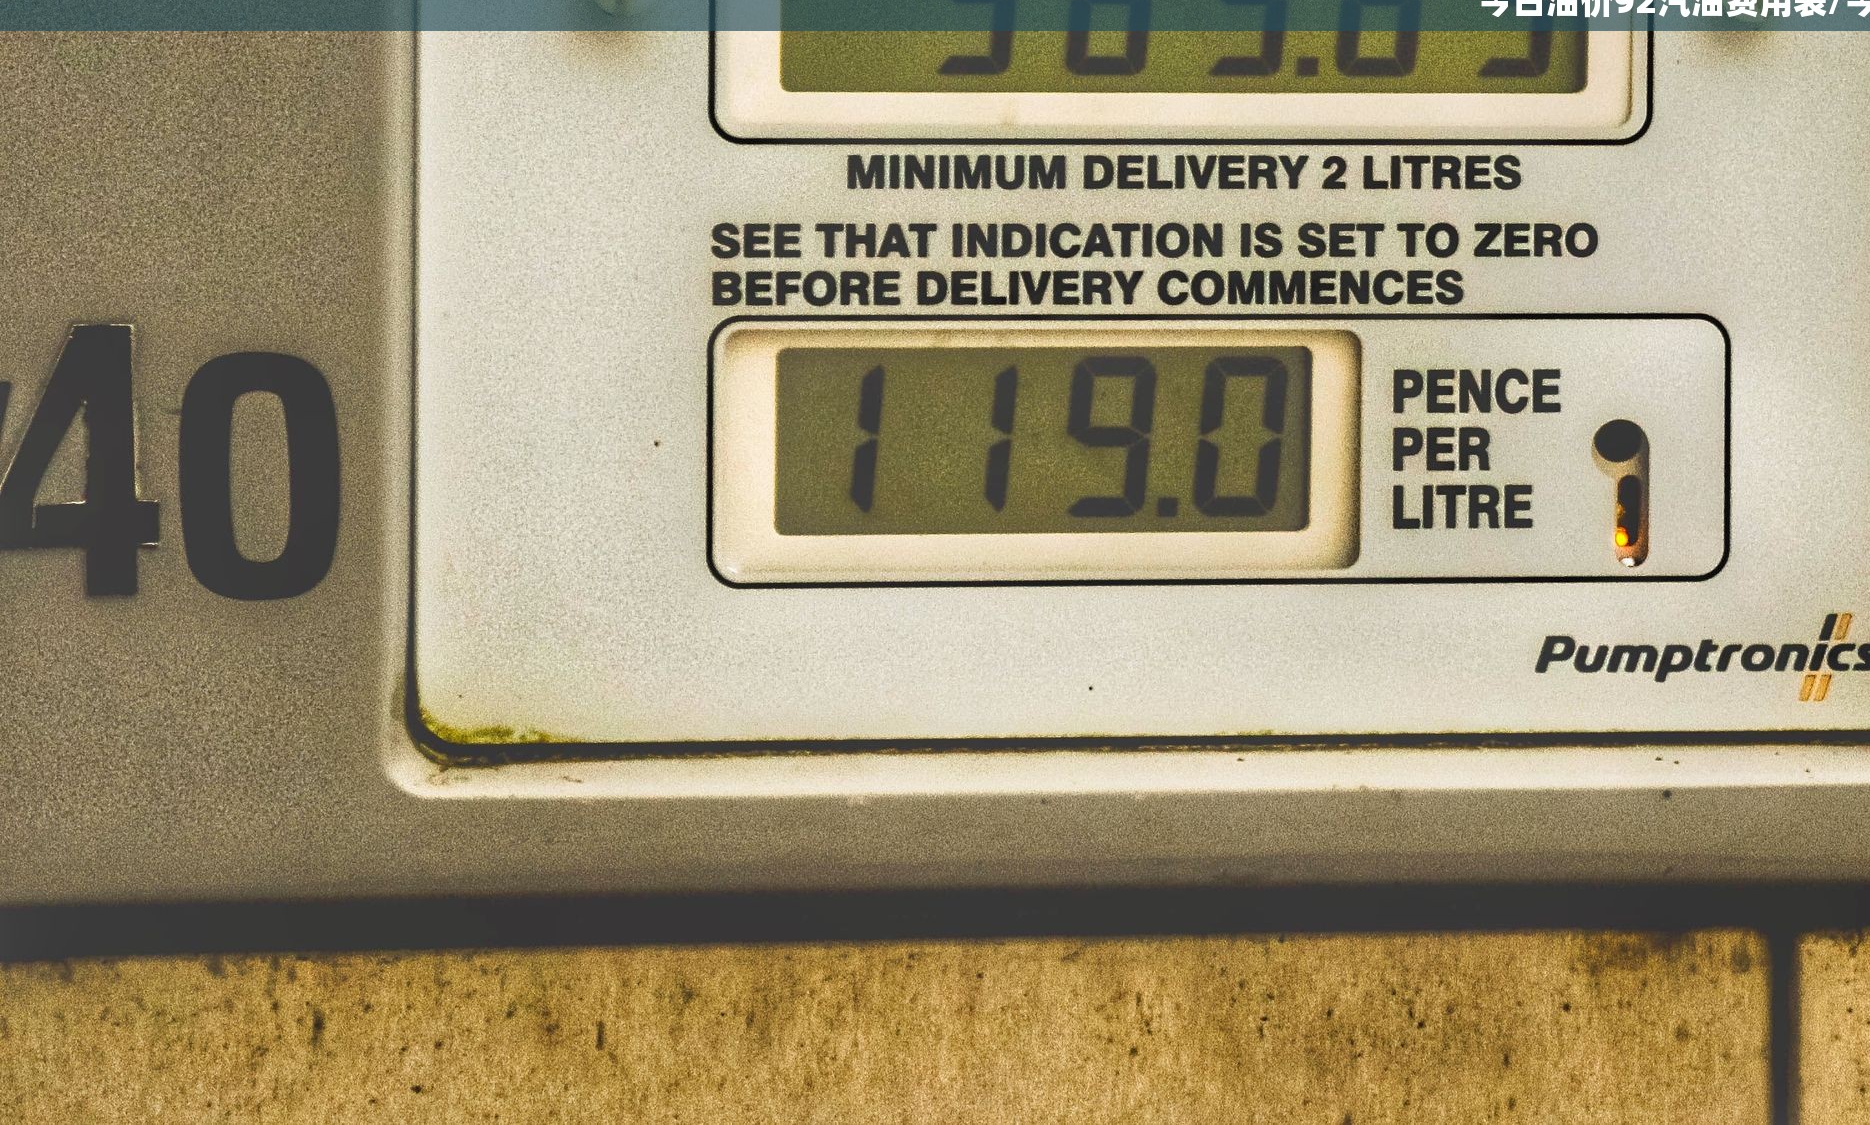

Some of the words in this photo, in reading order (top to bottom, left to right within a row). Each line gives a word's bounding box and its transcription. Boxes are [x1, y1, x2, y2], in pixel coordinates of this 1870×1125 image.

[846, 154, 1067, 191] MINIMUM
[1082, 154, 1309, 191] DELIVERY
[1321, 154, 1348, 191] 2
[1362, 154, 1523, 191] LITRES
[711, 222, 802, 260] SEE
[815, 222, 938, 259] THAT
[951, 222, 1224, 260] INDICATION
[1239, 222, 1284, 260] IS
[1297, 222, 1386, 260] SET
[1396, 222, 1461, 259] TO
[1473, 222, 1600, 259] ZERO
[711, 269, 901, 308] BEFORE
[916, 269, 1144, 307] DELIVERY
[1156, 269, 1465, 307] COMMENCES
[1392, 368, 1562, 415] PENCE
[845, 352, 1292, 520] 119.0
[1392, 425, 1492, 472] PER
[0, 323, 341, 601] 40
[1392, 483, 1535, 531] LITRE
